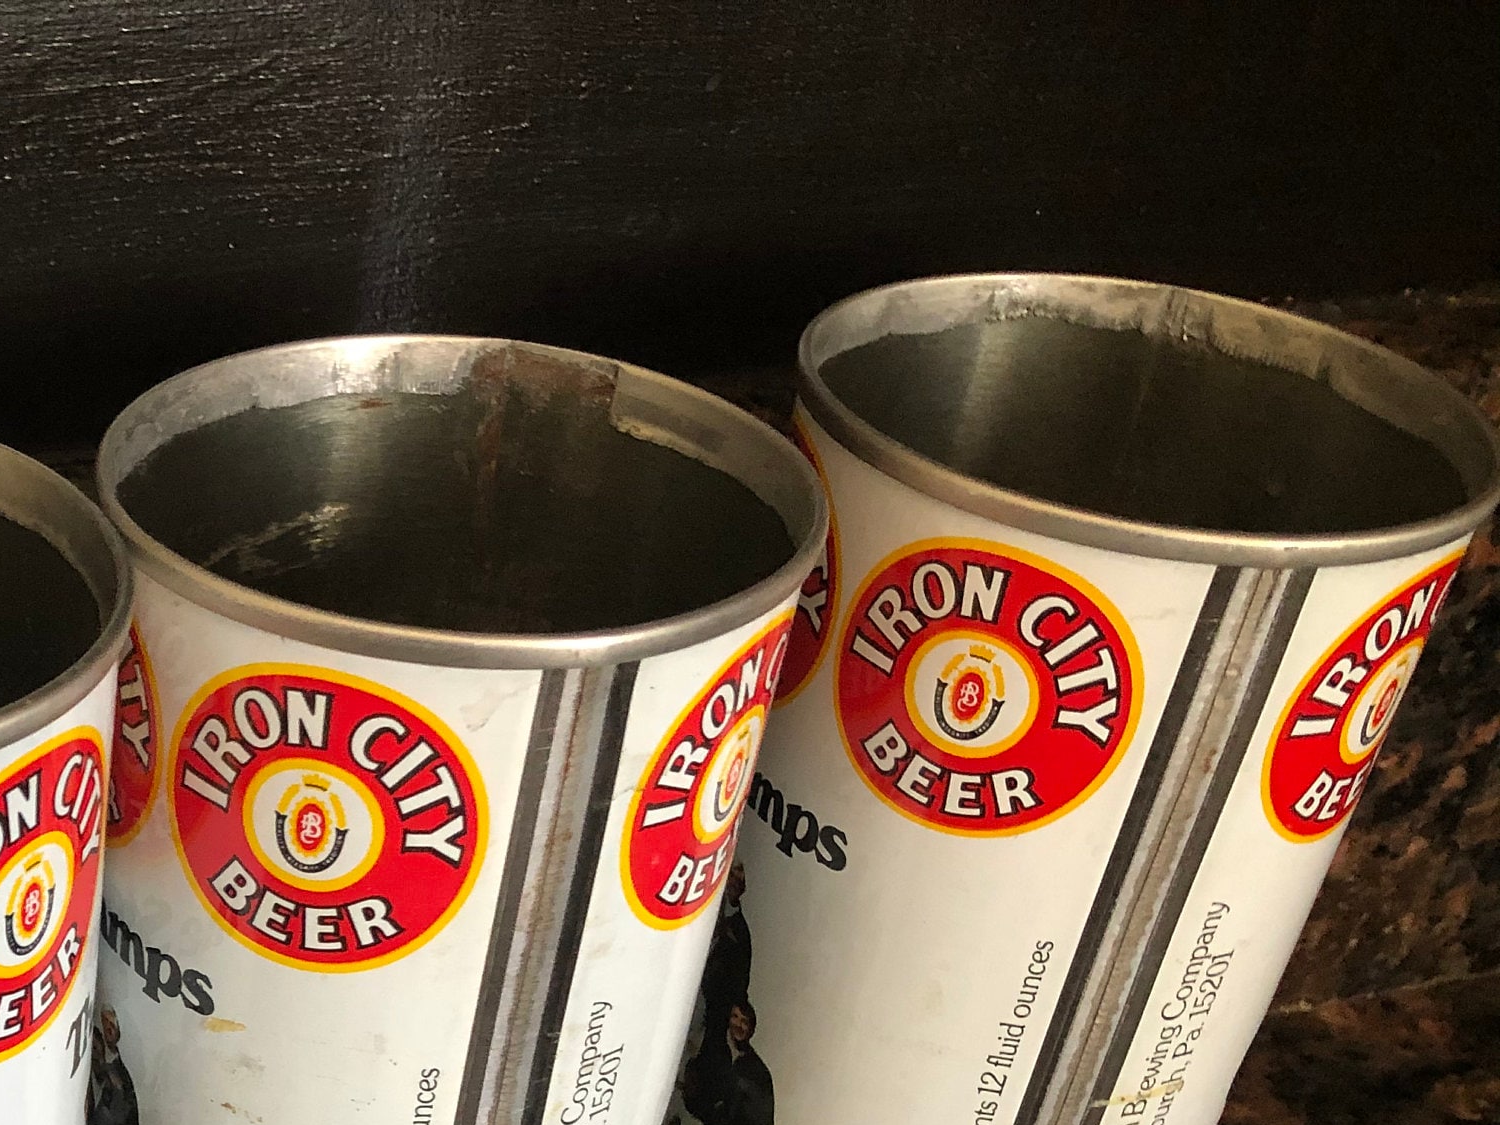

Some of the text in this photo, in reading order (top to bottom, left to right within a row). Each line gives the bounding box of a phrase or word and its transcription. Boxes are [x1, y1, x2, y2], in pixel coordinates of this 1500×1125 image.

[852, 562, 1011, 677] IRON
[1017, 594, 1120, 750] CITY
[1289, 580, 1437, 737] IRON
[181, 686, 333, 813] IRON
[348, 713, 469, 869] CITY
[641, 647, 764, 828] IRON
[861, 718, 1044, 817] BEER
[1293, 764, 1369, 822] BEE
[207, 854, 404, 952] BEER
[1012, 940, 1055, 1018] ounces
[1121, 1023, 1183, 1119] Brewing
[1160, 901, 1230, 1023] Company
[1188, 949, 1235, 1023] 15201
[560, 1001, 613, 1125] Company
[589, 1043, 625, 1119] 15201
[977, 1071, 1008, 1097] 12
[986, 1022, 1026, 1069] fluid
[1172, 1022, 1205, 1061] Pa.
